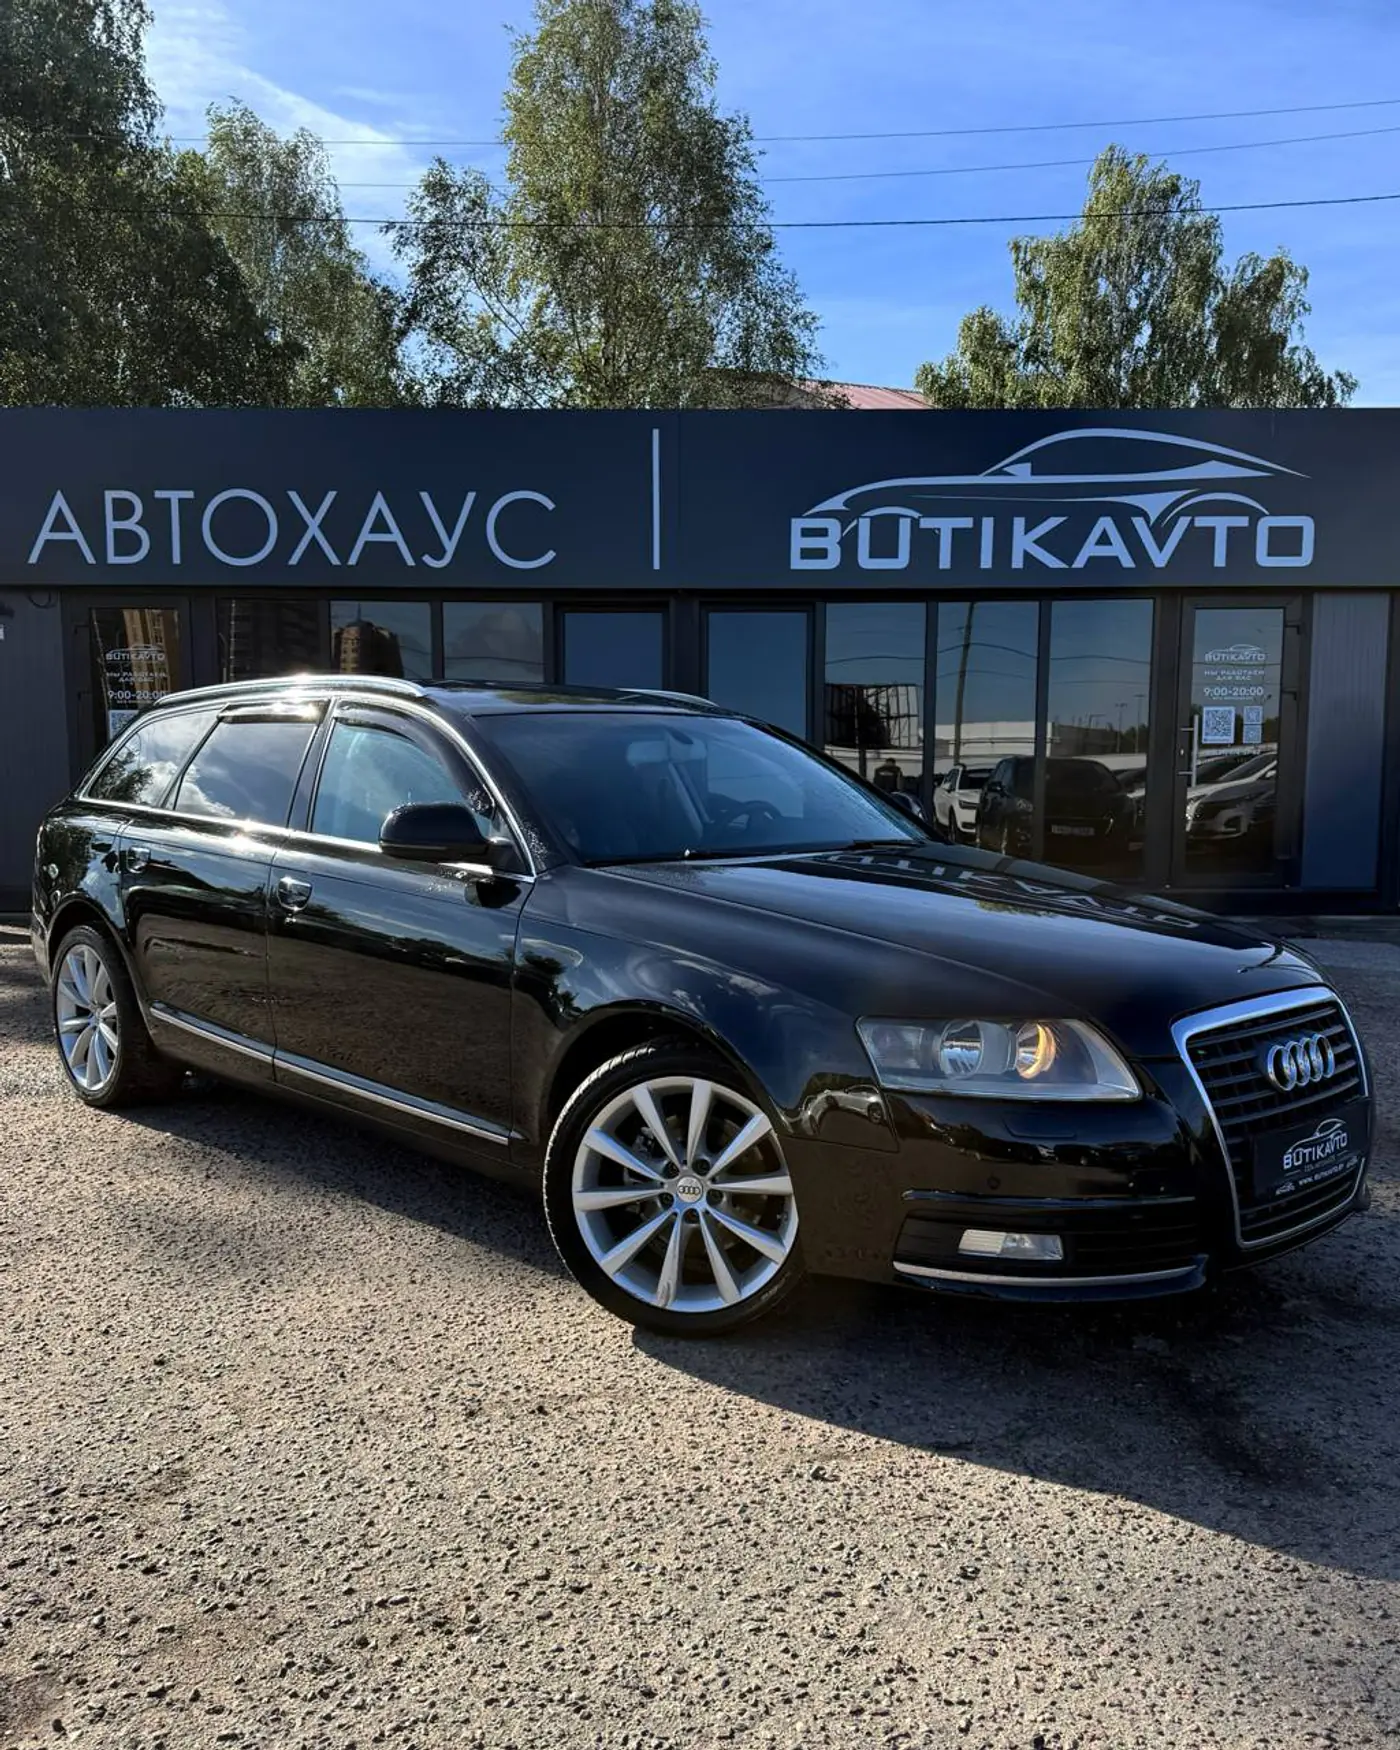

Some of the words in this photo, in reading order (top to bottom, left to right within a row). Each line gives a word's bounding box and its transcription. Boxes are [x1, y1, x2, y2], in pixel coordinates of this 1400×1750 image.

[28, 488, 558, 570] АВТОХАУС
[790, 514, 1316, 570] BUTIKAVTO
[1203, 686, 1264, 696] 9:00-20:00
[1283, 1132, 1348, 1170] BUTIKAVTO
